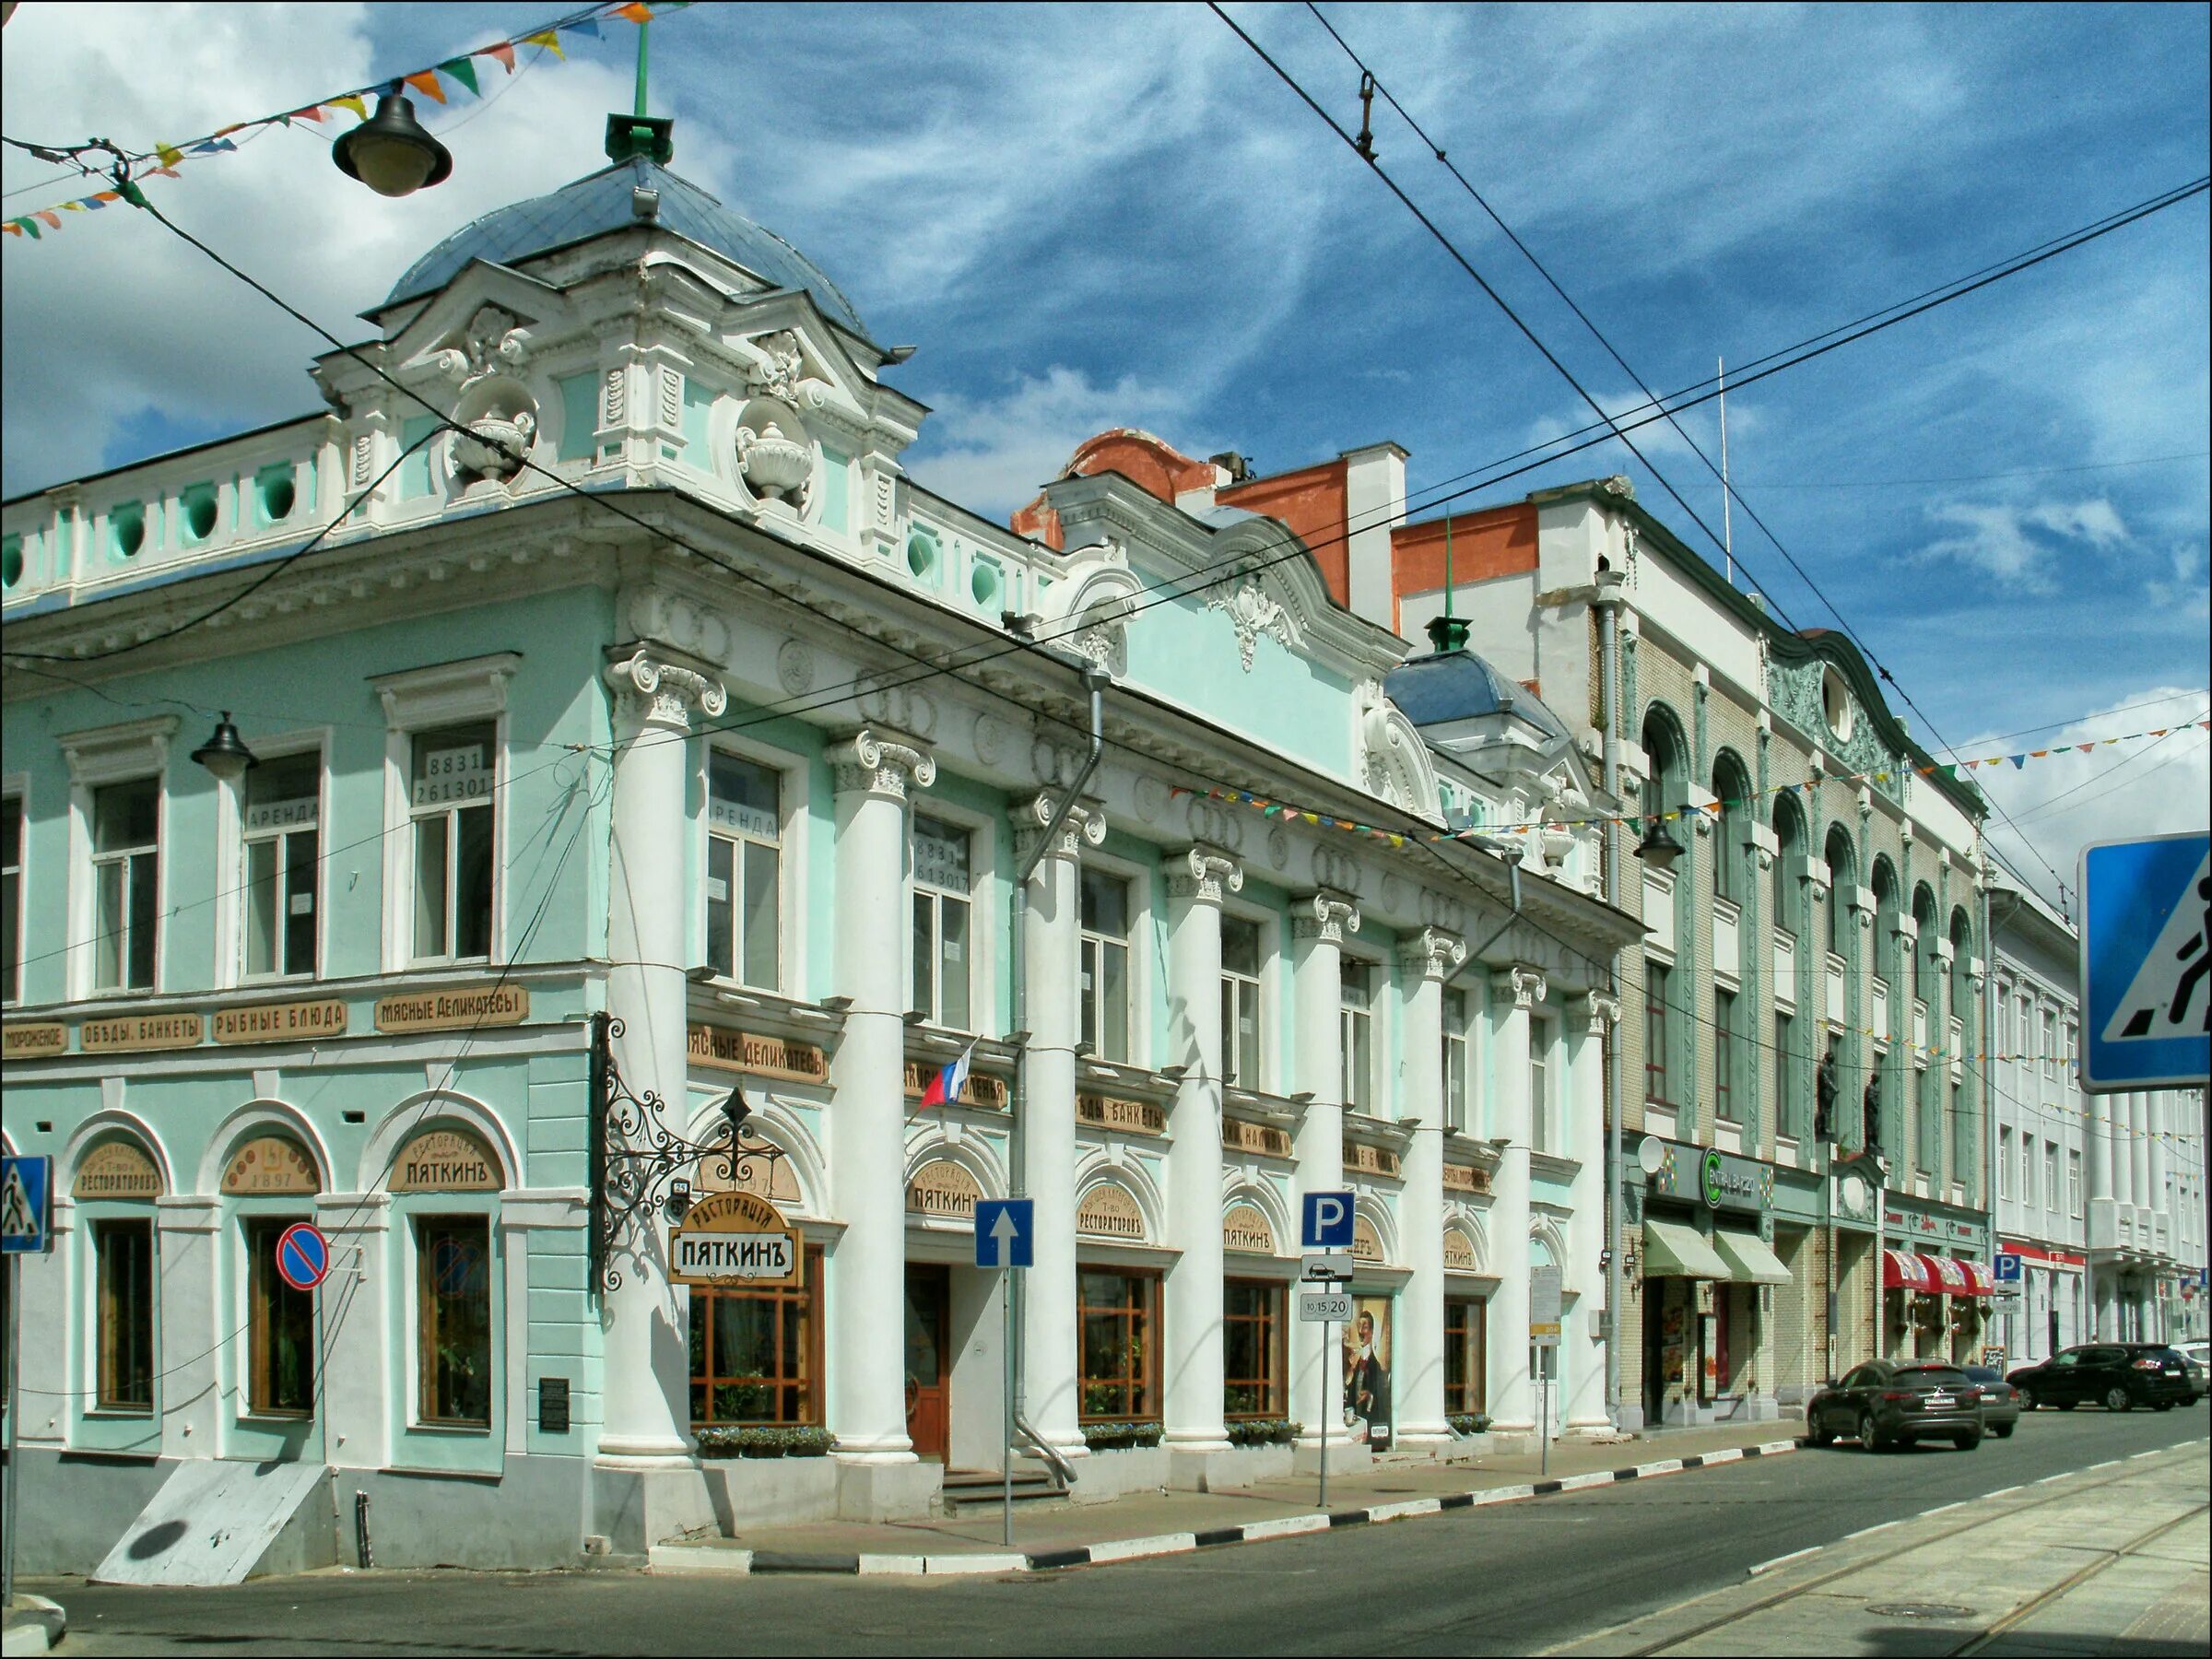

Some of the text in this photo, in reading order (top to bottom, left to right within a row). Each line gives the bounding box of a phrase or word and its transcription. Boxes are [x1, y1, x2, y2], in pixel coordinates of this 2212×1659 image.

[430, 752, 479, 775] 8831
[417, 777, 494, 803] 261301
[250, 803, 317, 827] АРЕНДА
[709, 802, 775, 837] РЕНДА
[918, 840, 955, 865] 8831
[216, 1005, 344, 1034] РЫБНЫЕ БЛЮДА
[382, 993, 519, 1024] МЯСНЫЕ ДЕЛИКАТЕСЫ
[6, 1028, 62, 1048] МОРОЖЕНОЕ
[139, 1018, 198, 1039] БАНКЕТЫ
[745, 1041, 826, 1077] ДЕЛИКАТЕСЫ
[1112, 1103, 1164, 1129] БАНКЕТЫ
[406, 1162, 488, 1183] ПЯТКИНЪ
[1080, 1212, 1140, 1233] РЕСТОРАТОРОВЪ
[1315, 1198, 1344, 1241] P
[1224, 1229, 1270, 1249] ПЯТКИНЪ
[682, 1241, 786, 1267] ПЯТКИНЪ
[2000, 1256, 2015, 1277] P
[1318, 1301, 1327, 1312] 15
[1330, 1300, 1346, 1312] 20
